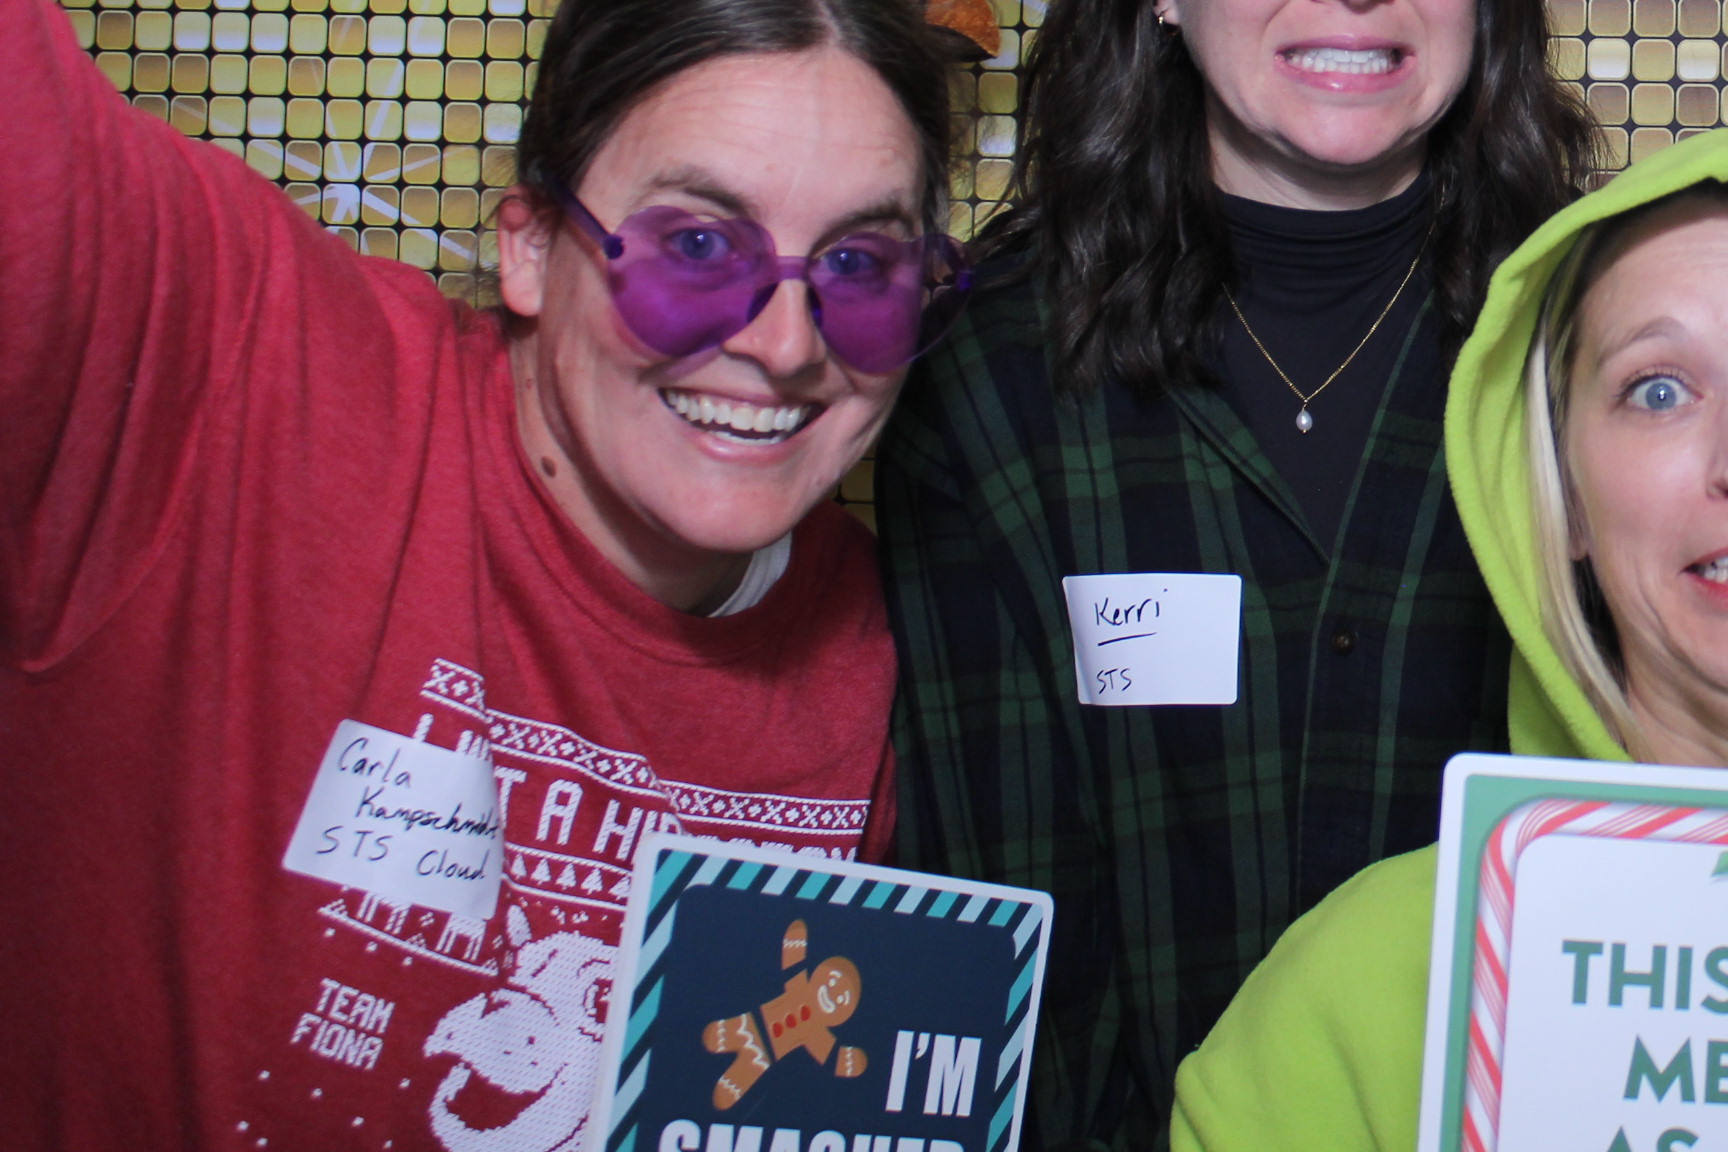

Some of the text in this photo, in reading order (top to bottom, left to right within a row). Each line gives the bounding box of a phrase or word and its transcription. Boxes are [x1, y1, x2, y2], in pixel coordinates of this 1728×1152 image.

[1094, 588, 1168, 626] Kerri
[1096, 667, 1132, 695] STS
[337, 737, 411, 788] Carla
[537, 779, 583, 845] A
[316, 825, 490, 880] STS Cloud
[320, 977, 396, 1034] TEAM
[290, 1012, 383, 1070] FIONA
[884, 1030, 982, 1118] I'M
